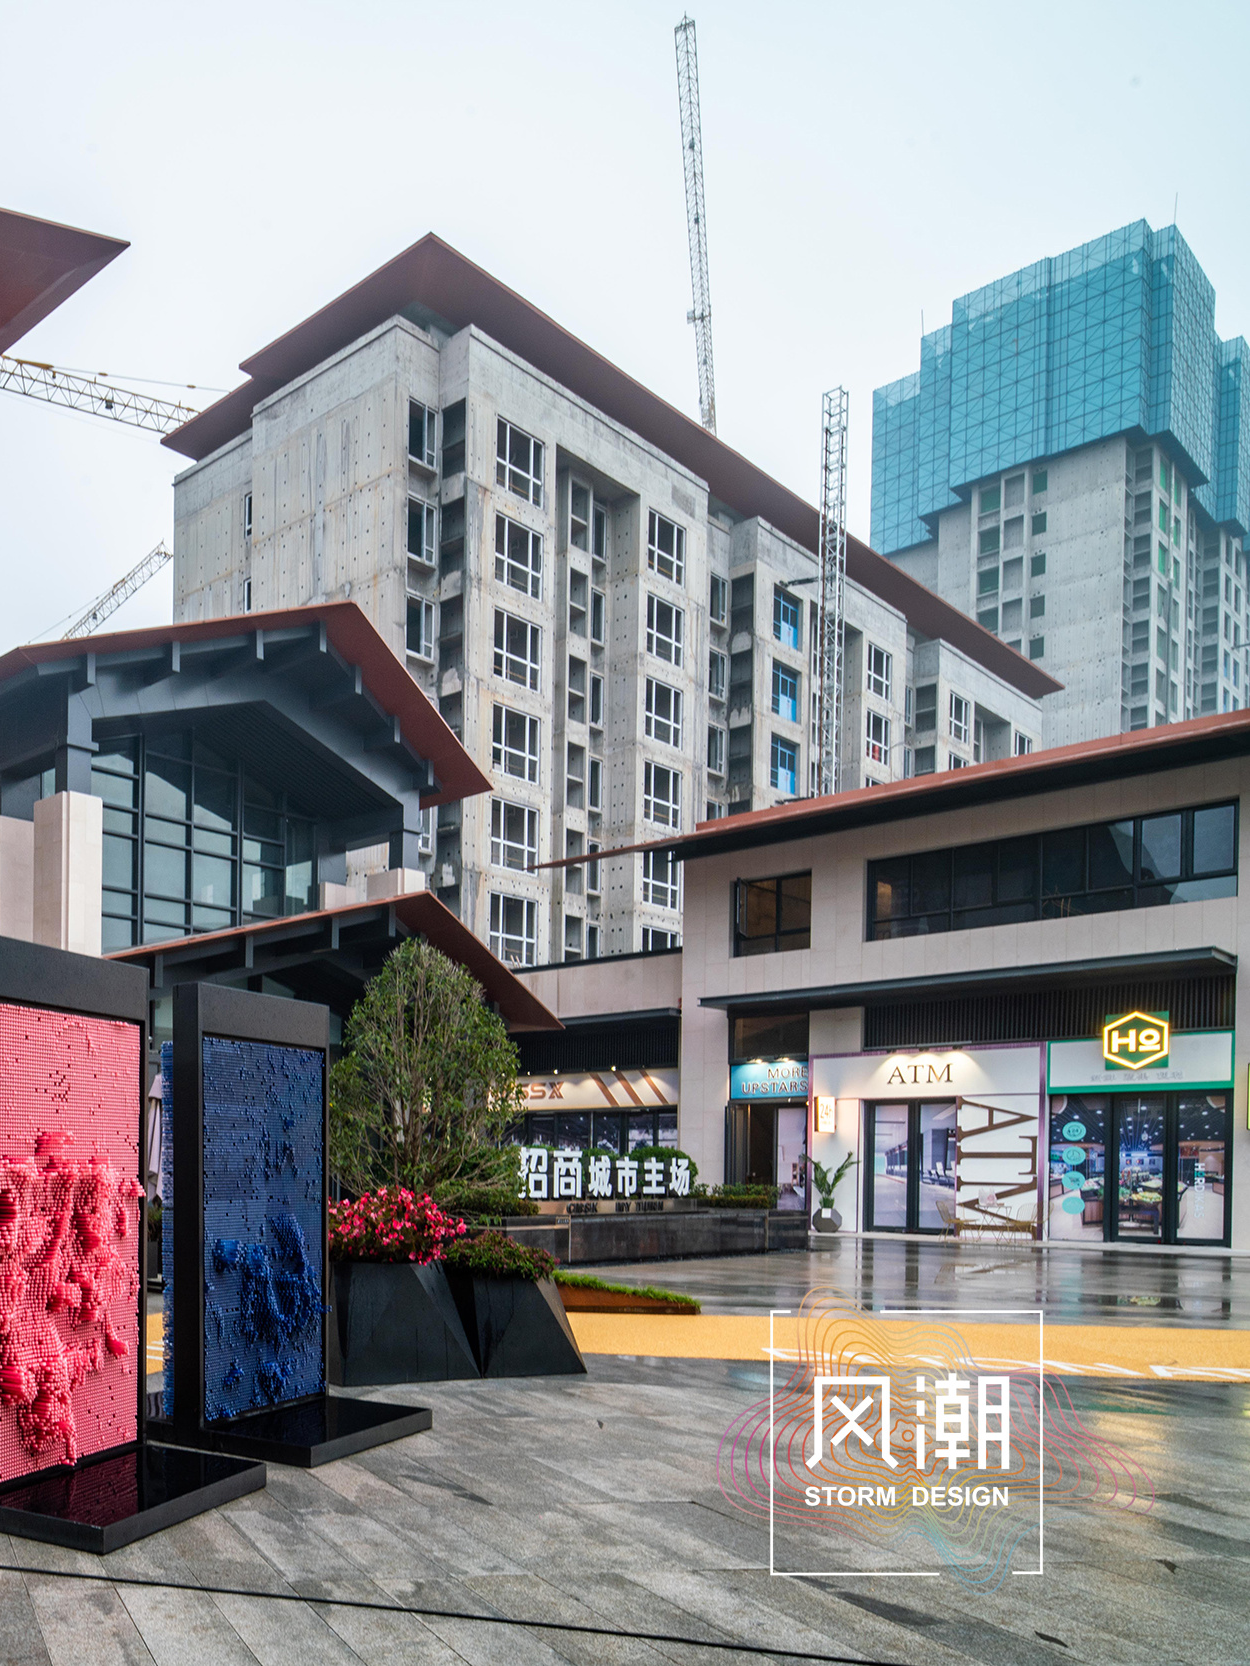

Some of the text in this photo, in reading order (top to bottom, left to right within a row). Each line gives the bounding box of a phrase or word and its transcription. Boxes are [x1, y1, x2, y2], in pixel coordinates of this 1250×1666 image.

[767, 1066, 808, 1079] MORE
[887, 1063, 953, 1085] ATM
[741, 1081, 808, 1095] UPSTARS
[518, 1147, 690, 1199] 招商城市主场
